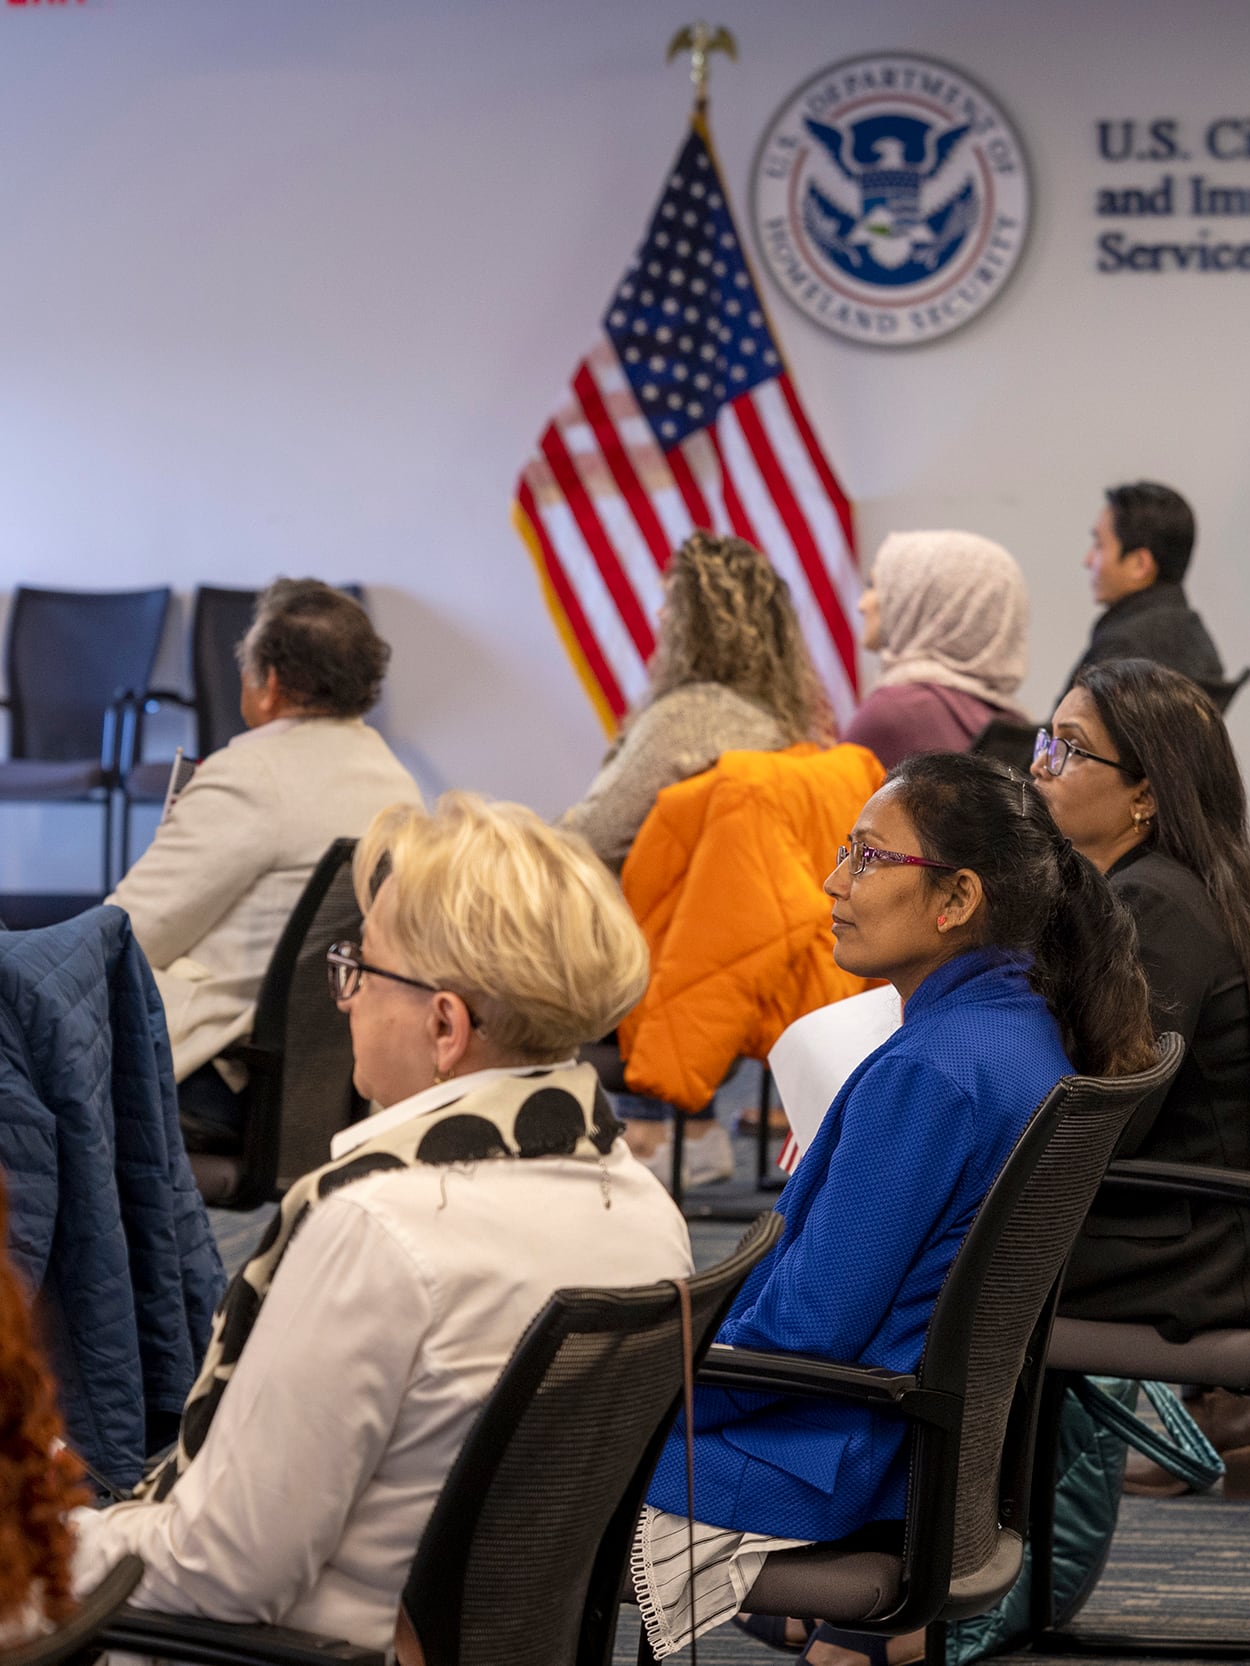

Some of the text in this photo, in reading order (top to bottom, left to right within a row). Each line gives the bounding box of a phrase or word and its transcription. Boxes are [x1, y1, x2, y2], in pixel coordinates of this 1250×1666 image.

[807, 67, 995, 133] DEPARTMENT
[987, 137, 1015, 174] OF
[1096, 118, 1191, 161] U.S.
[1096, 175, 1173, 216] and
[766, 216, 1016, 333] HOMELAND SECURITY
